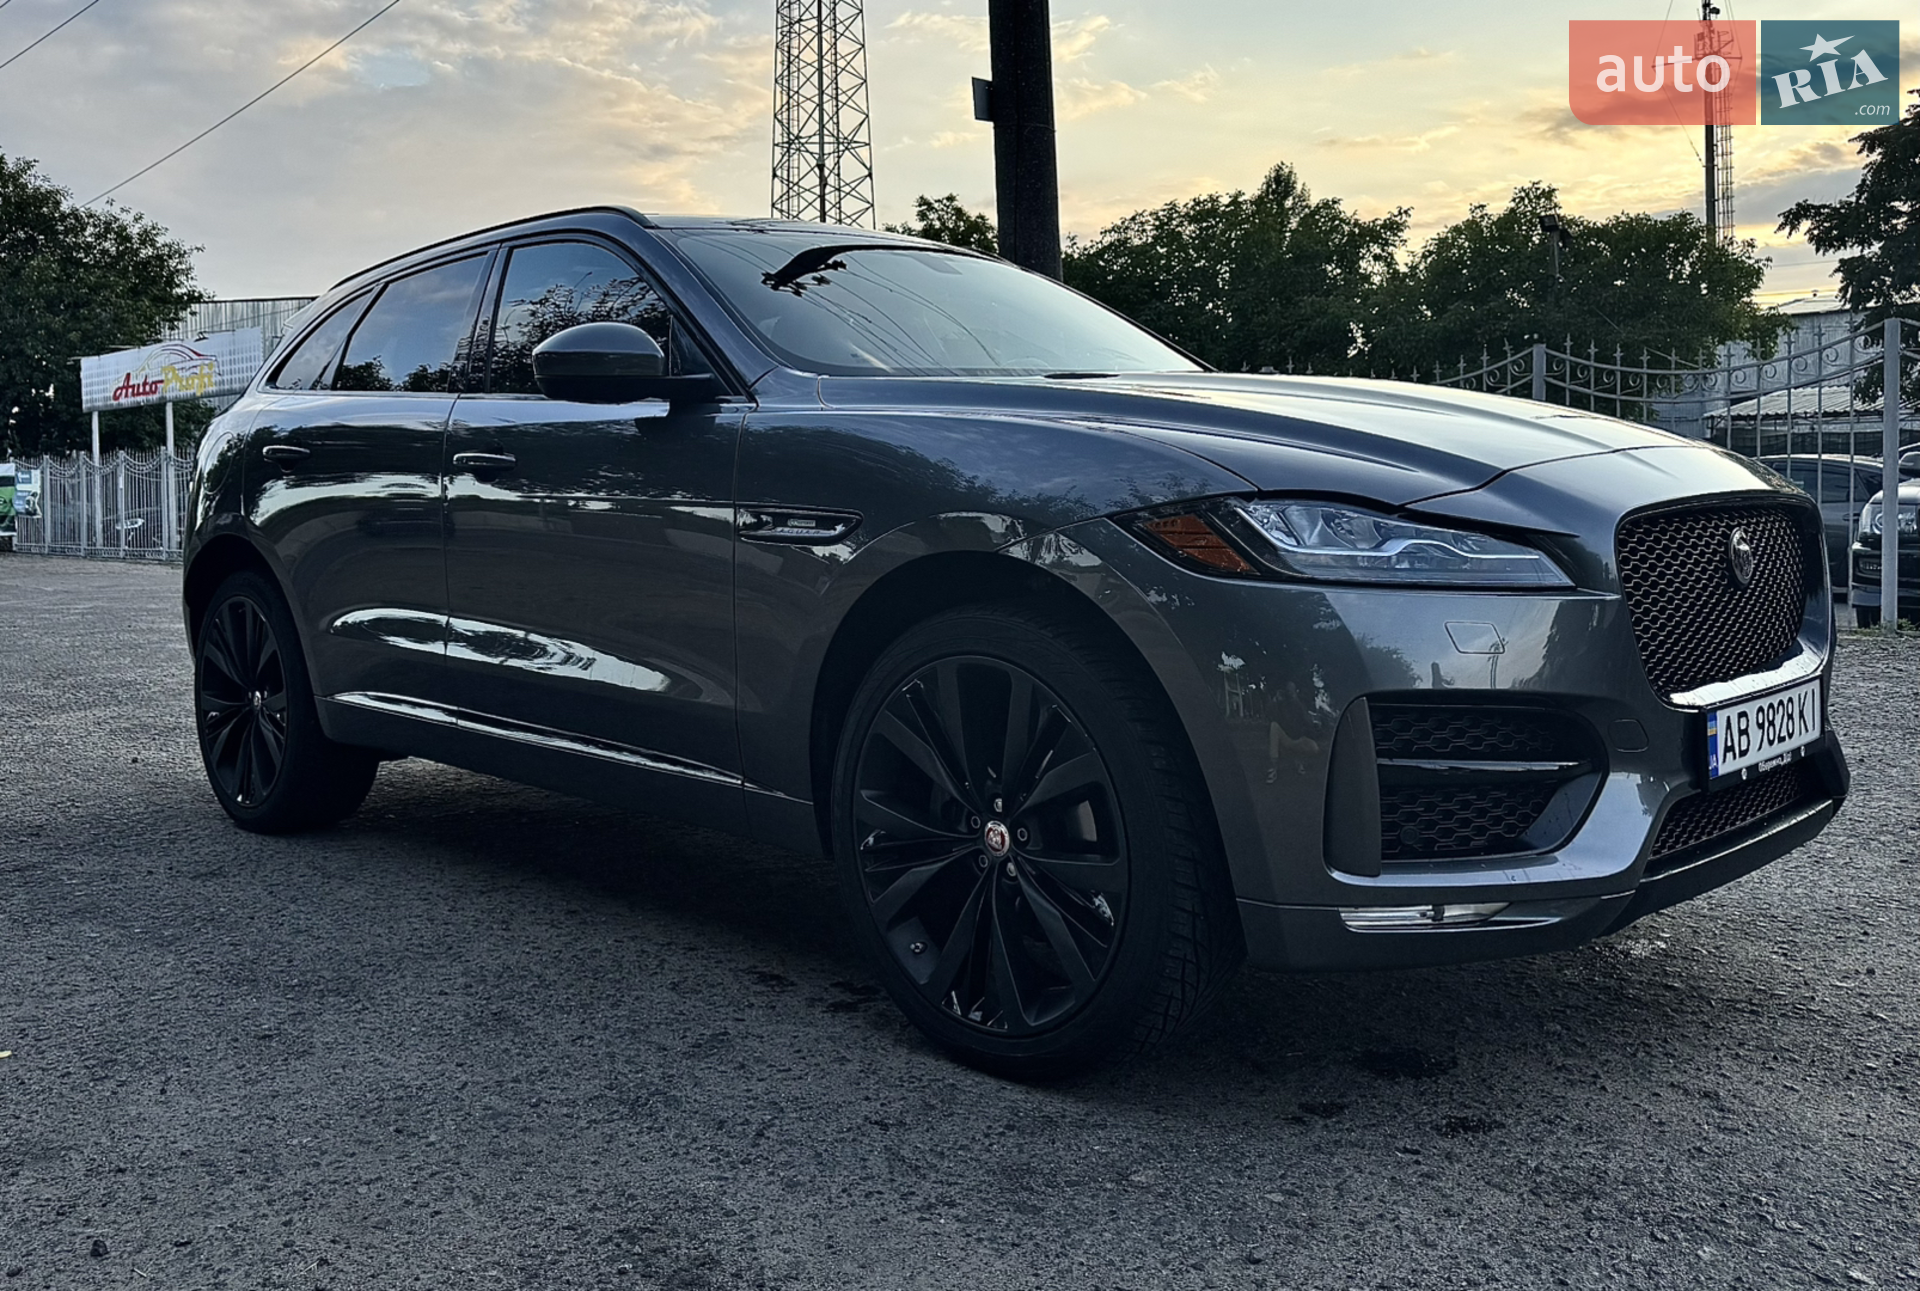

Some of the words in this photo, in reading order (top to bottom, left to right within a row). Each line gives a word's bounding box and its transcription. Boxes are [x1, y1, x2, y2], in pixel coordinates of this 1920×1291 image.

[1722, 710, 1751, 764] AB
[1756, 696, 1795, 752] 9828
[1798, 688, 1816, 736] KI
